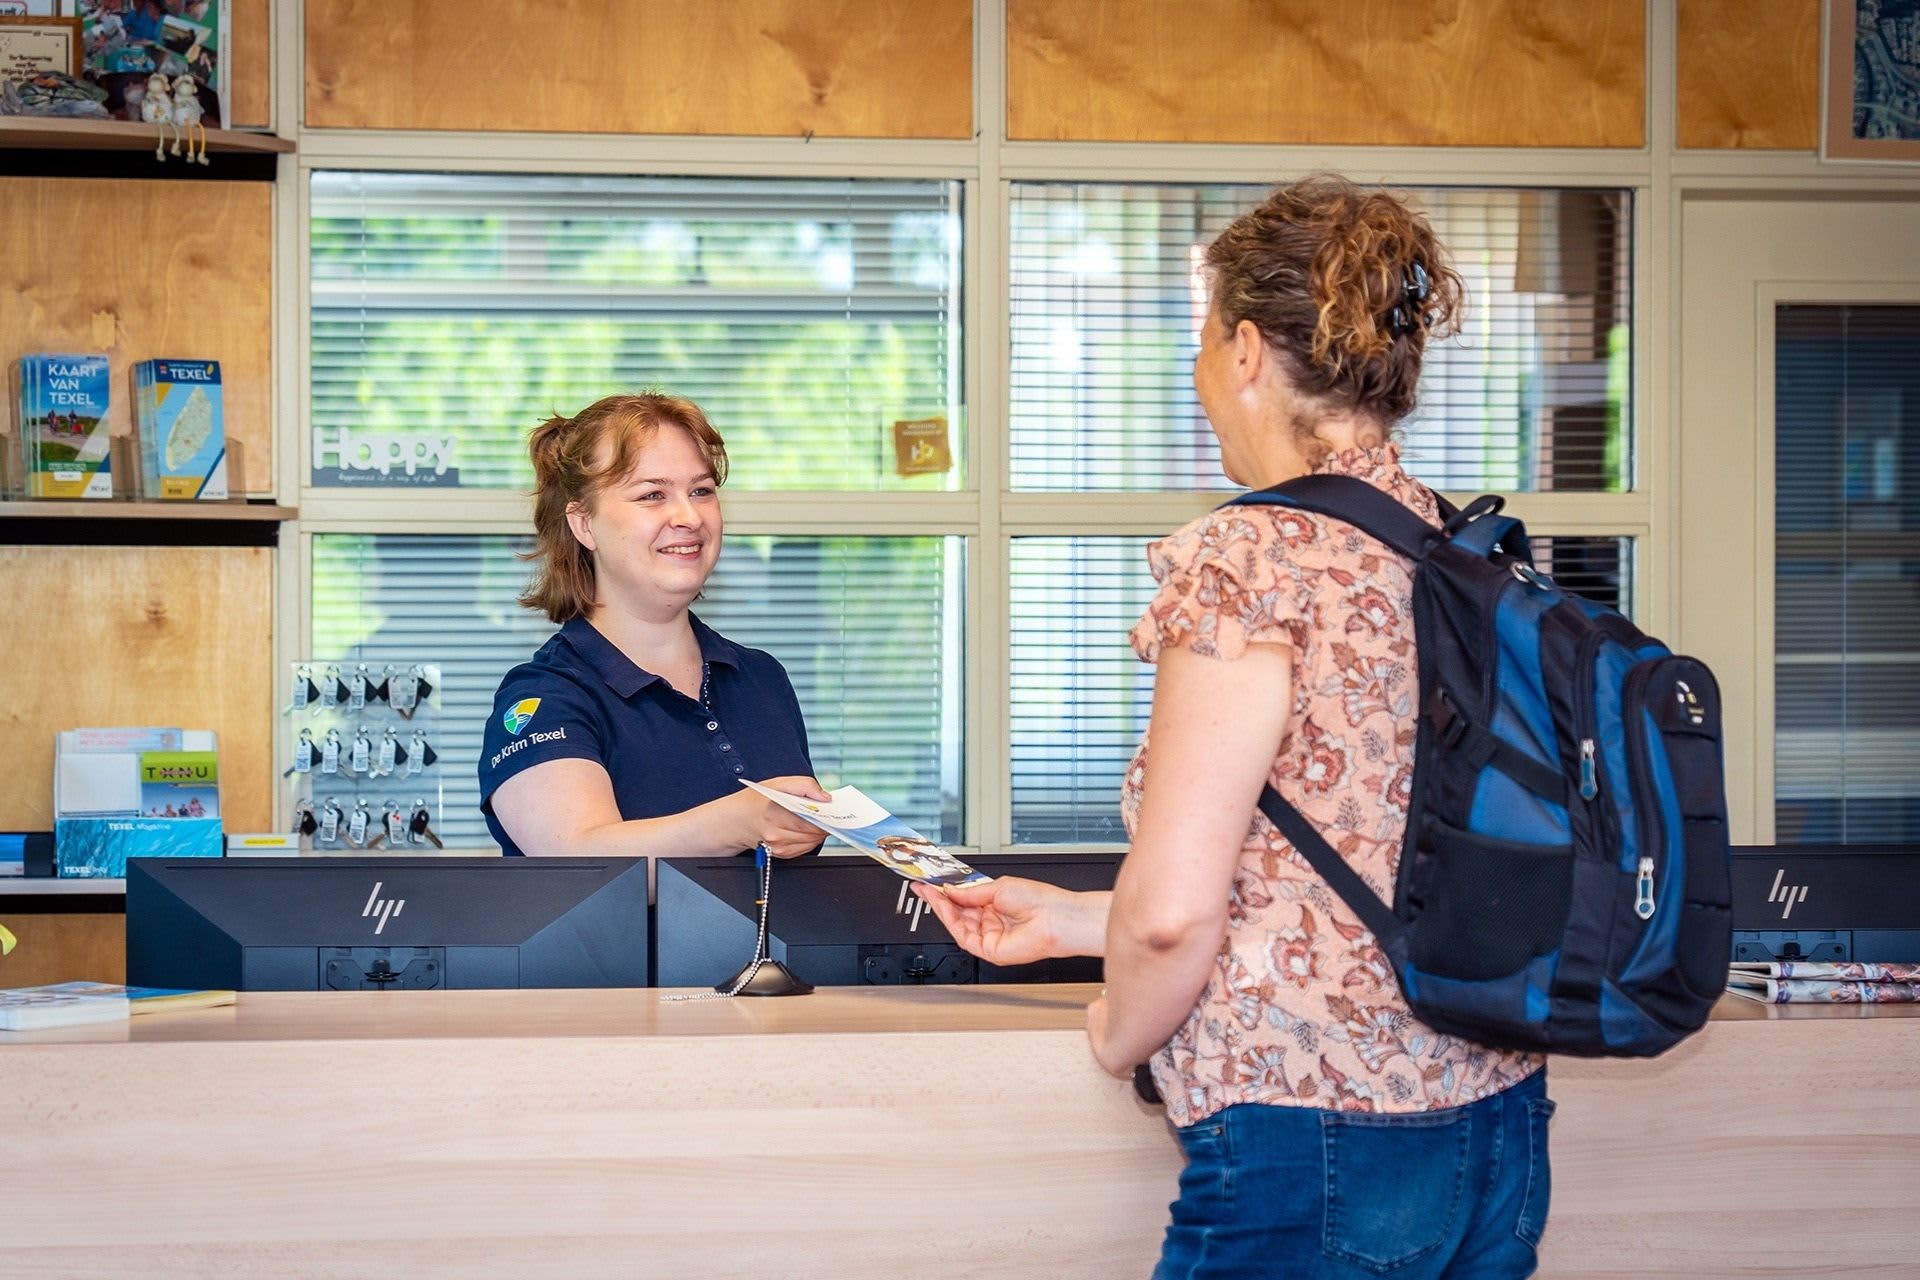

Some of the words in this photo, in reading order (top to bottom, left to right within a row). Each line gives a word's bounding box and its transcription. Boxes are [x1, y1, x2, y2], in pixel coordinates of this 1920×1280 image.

[48, 364, 97, 377] KAART
[169, 369, 211, 380] TEXEL
[49, 378, 80, 391] VAN
[49, 392, 95, 405] TEXEL
[313, 426, 457, 476] Happy
[491, 754, 502, 769] De
[501, 738, 529, 760] Krim
[529, 727, 567, 745] Texel
[108, 822, 135, 831] TEXEL
[64, 866, 91, 874] TEXEL
[1768, 869, 1809, 919] hp
[362, 881, 406, 935] hp
